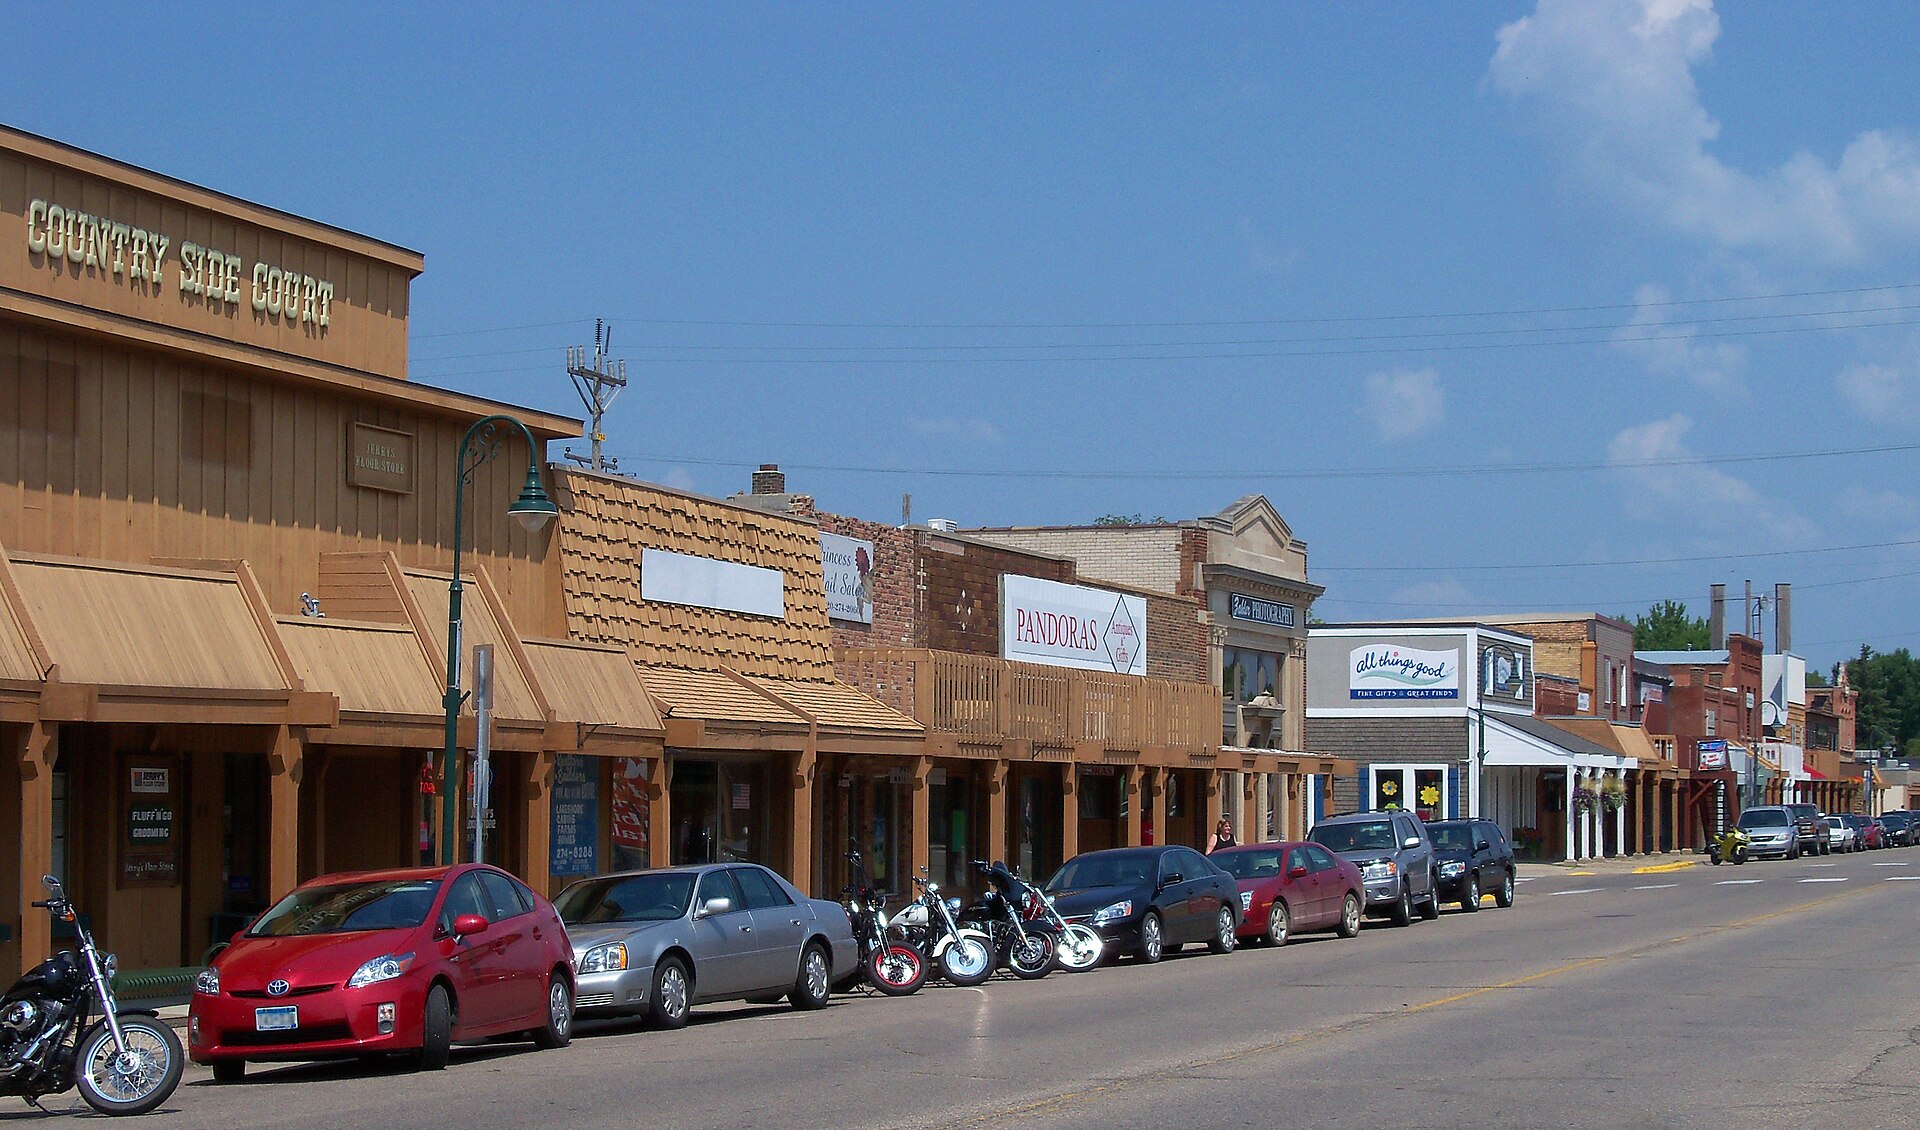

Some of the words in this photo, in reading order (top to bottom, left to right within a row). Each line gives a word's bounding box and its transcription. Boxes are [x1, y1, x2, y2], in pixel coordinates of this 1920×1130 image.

[28, 199, 169, 285] COUNTRY
[180, 240, 242, 305] SIDE
[252, 261, 334, 328] COURT
[355, 455, 380, 471] FLOOR
[381, 460, 405, 475] STORE
[1251, 601, 1294, 625] PHOTOGRAPHY
[1016, 607, 1098, 652] PANDORAS
[1356, 651, 1377, 674] all
[1378, 650, 1417, 675] things
[1415, 661, 1446, 679] good
[1406, 690, 1429, 698] GREAT
[132, 827, 170, 838] GROOMING
[557, 824, 577, 835] FARMS
